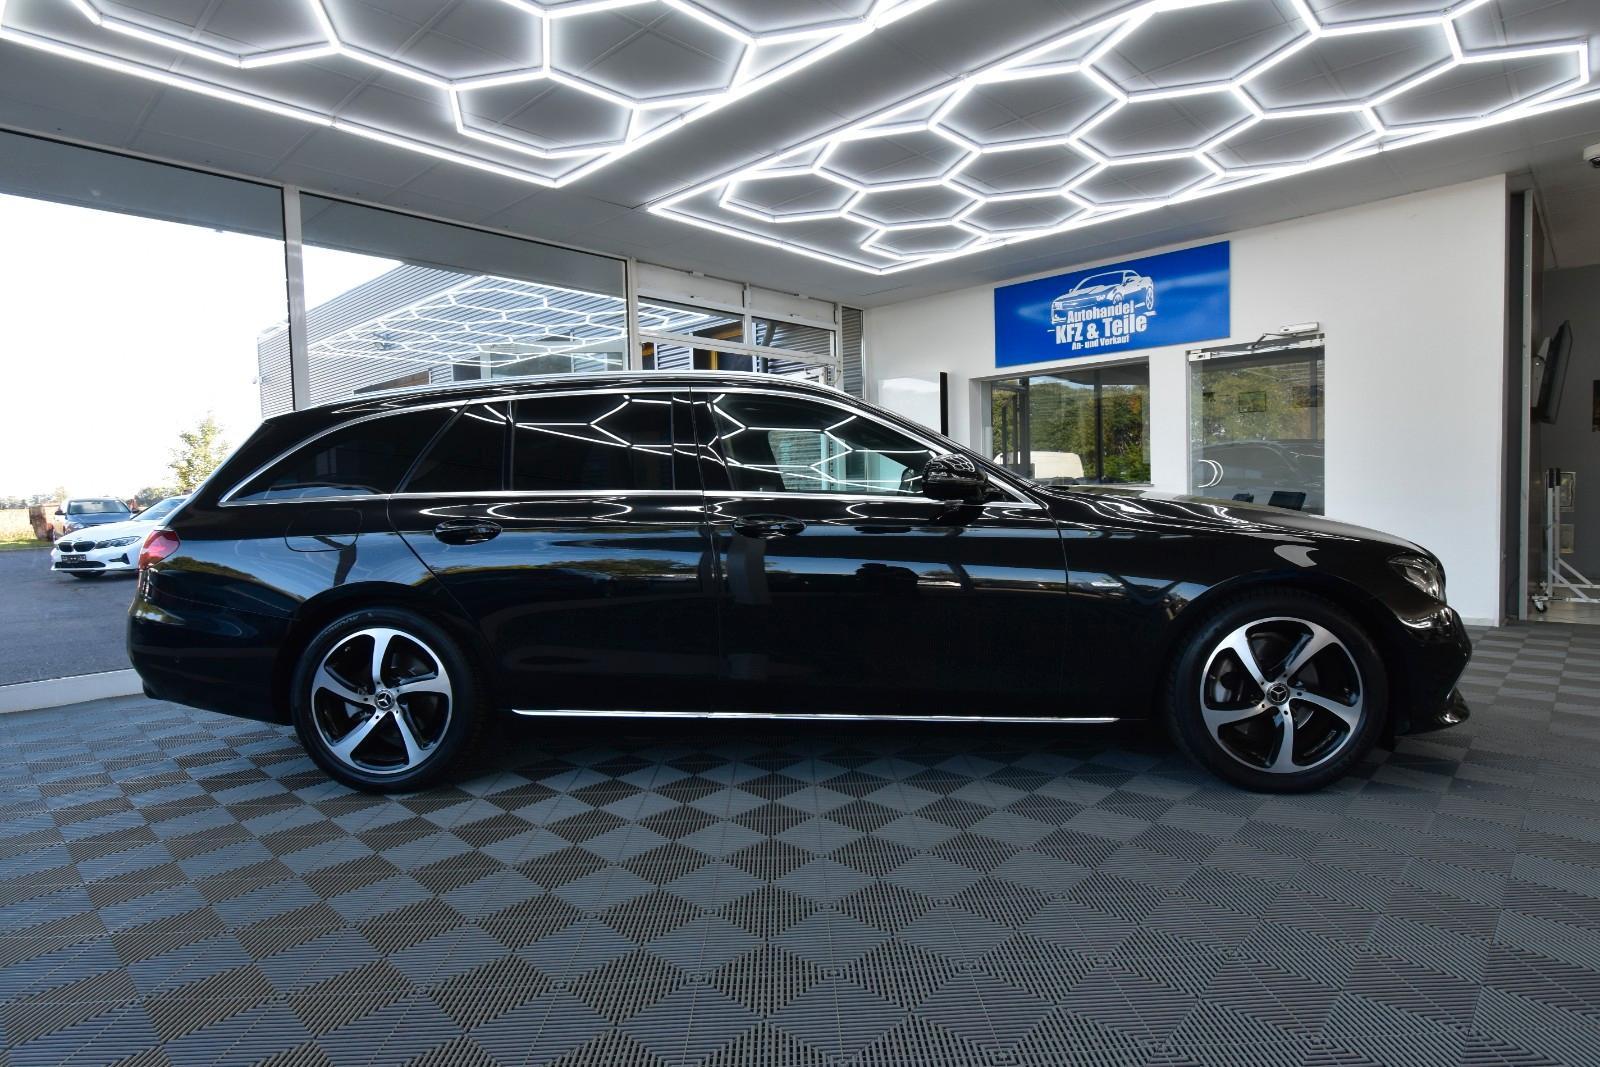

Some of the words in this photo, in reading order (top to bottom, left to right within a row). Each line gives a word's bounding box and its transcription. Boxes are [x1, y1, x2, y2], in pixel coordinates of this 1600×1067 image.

[1067, 300, 1134, 323] Autohandel
[1055, 322, 1083, 344] KFZ
[1086, 323, 1099, 340] &
[1102, 314, 1147, 337] Teile
[1072, 342, 1084, 350] An-
[1085, 339, 1099, 348] und
[1100, 335, 1130, 346] Verkauf
